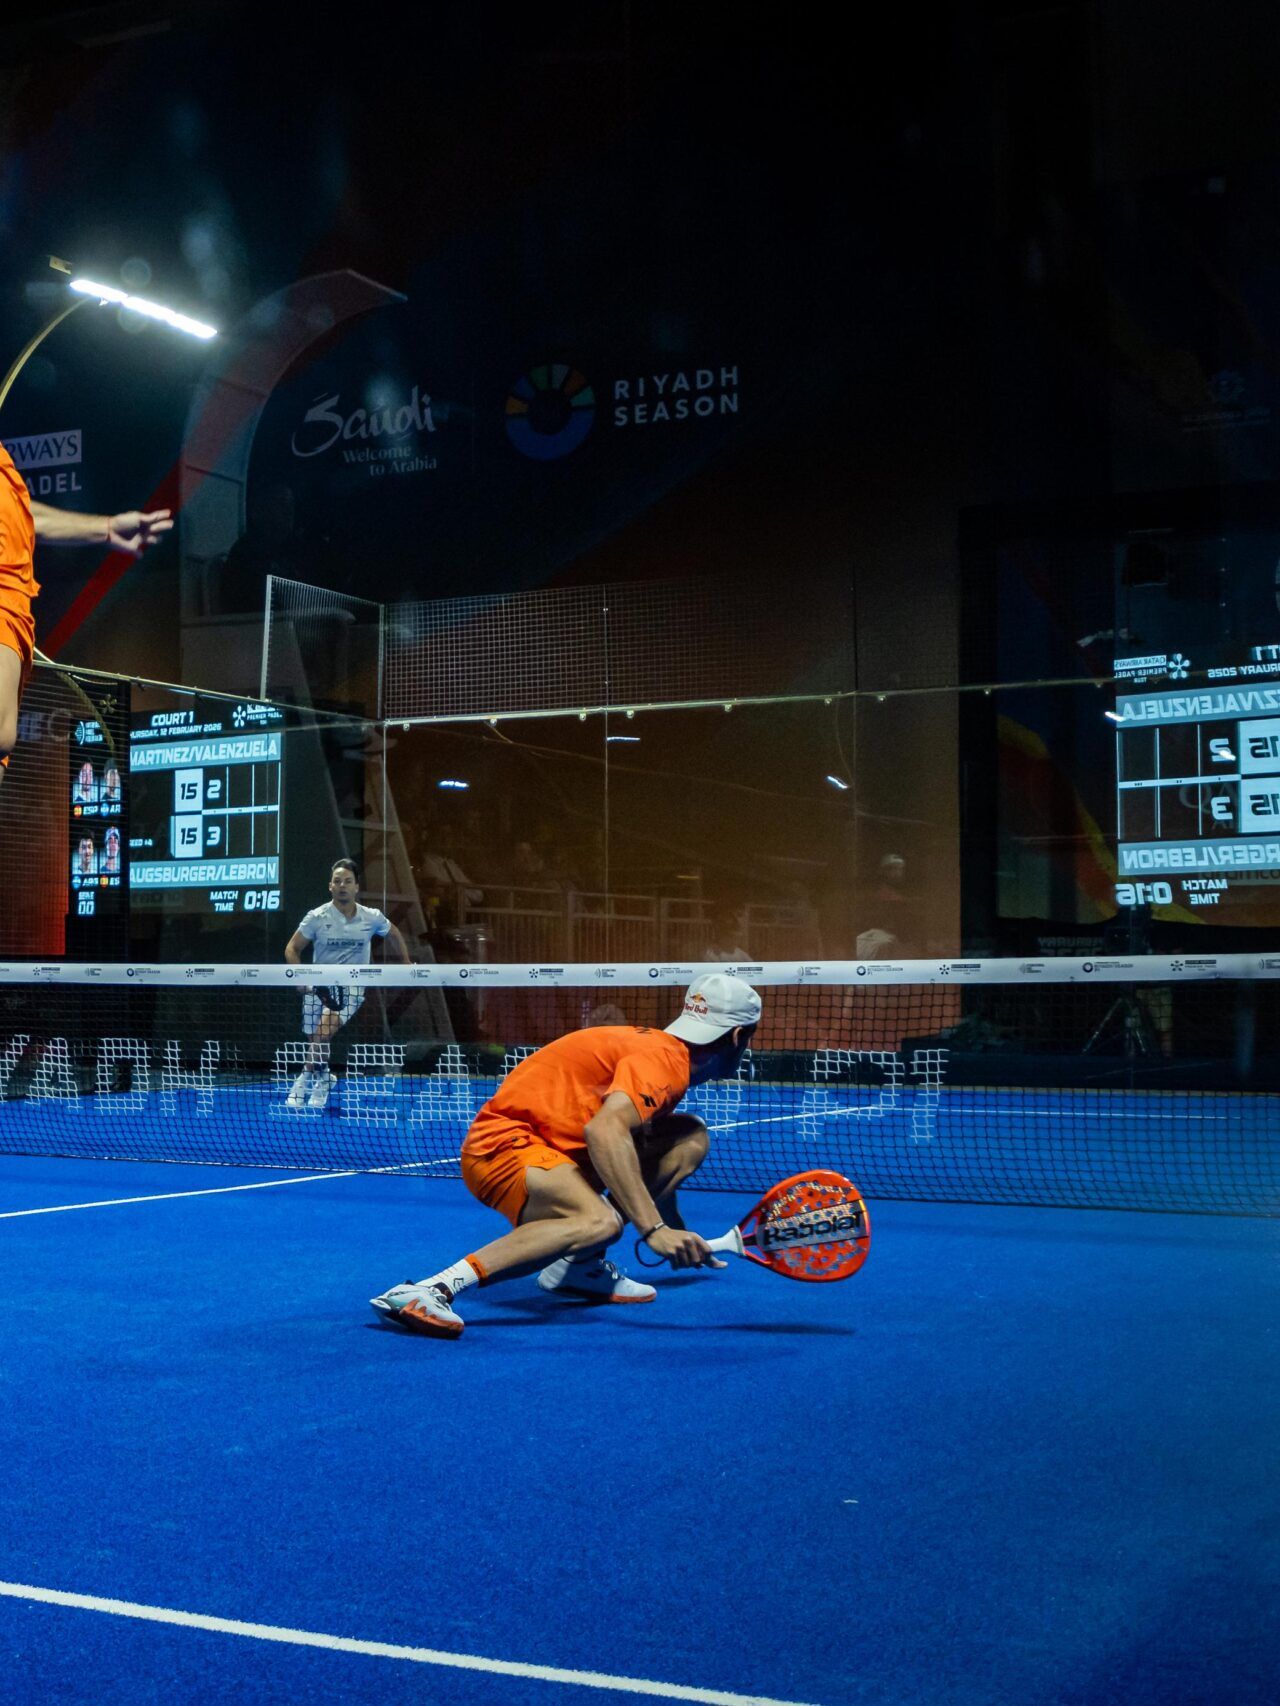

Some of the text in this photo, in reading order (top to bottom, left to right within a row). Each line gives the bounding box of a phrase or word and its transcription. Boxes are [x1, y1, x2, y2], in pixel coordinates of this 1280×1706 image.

[614, 365, 739, 400] RIYADH
[614, 392, 739, 427] SEASON
[5, 434, 78, 463] RWAYS
[342, 444, 412, 465] Welcome
[369, 455, 438, 476] to Arabia
[25, 471, 82, 496] ADEL
[151, 711, 195, 727] COURT 1
[169, 724, 202, 736] FEBRUARY
[180, 779, 222, 800] 15 2
[180, 826, 221, 845] 15 3
[129, 863, 276, 883] AUGSBURGER/LEBRON
[210, 890, 281, 910] MATCH 0:16
[214, 902, 234, 912] TIME
